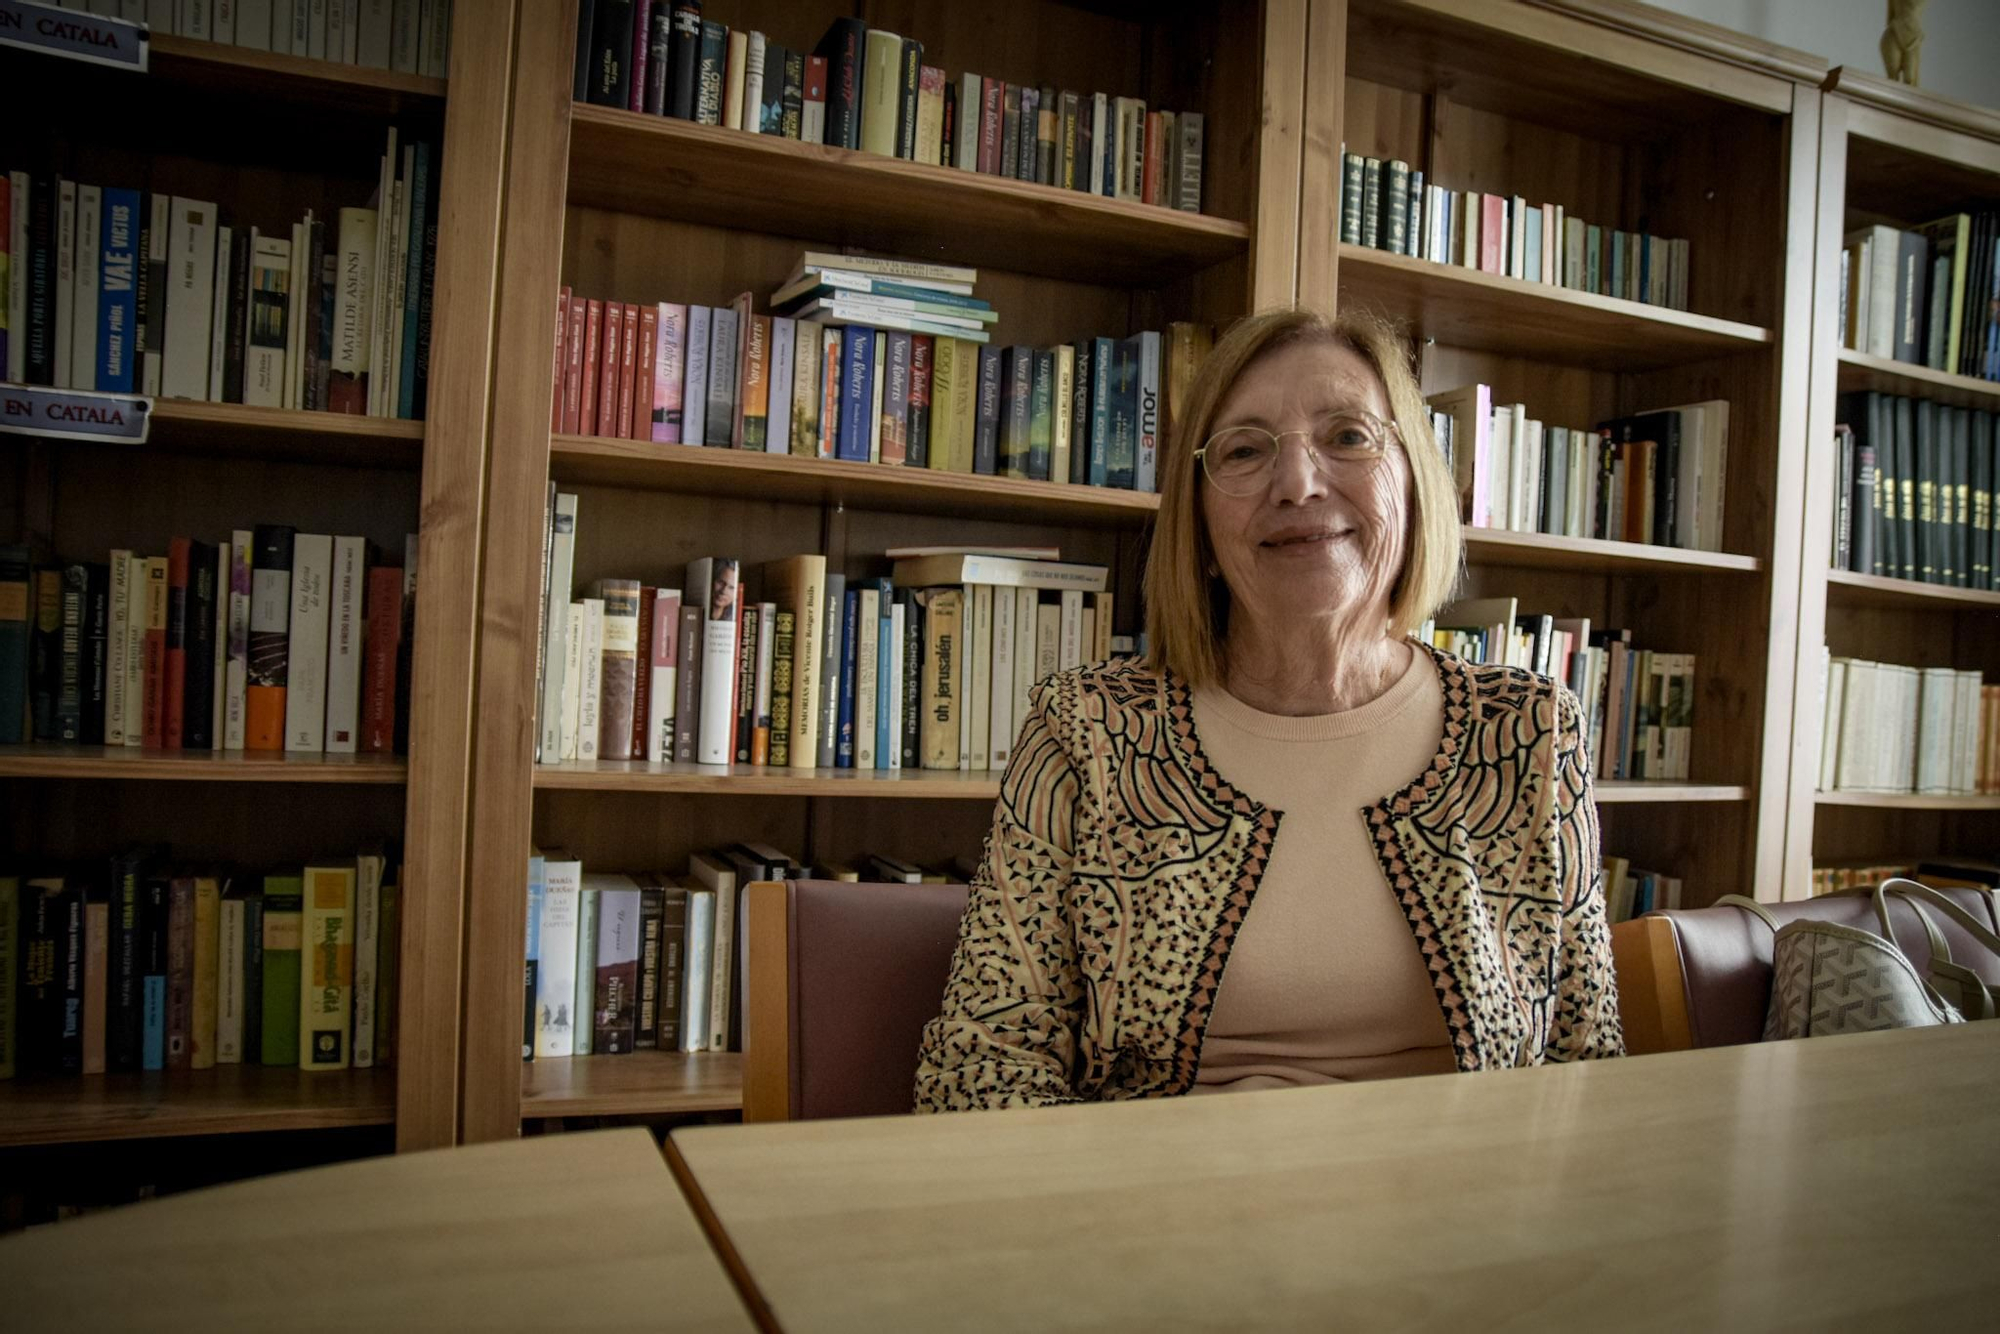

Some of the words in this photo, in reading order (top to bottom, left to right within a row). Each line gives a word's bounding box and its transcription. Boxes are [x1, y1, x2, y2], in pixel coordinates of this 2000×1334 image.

[710, 72, 721, 111] DIABLO
[1065, 159, 1074, 189] OMBRE
[111, 205, 130, 248] VICTUS
[139, 229, 149, 272] CAPITANA
[103, 251, 133, 291] VAE
[344, 251, 360, 298] ASENSI
[138, 274, 147, 301] VELLA
[108, 304, 124, 331] PIÑOL
[342, 300, 357, 361] MATILDE
[666, 314, 678, 336] Nora
[716, 320, 726, 352] LAURA
[749, 321, 764, 360] Roberts
[853, 335, 867, 359] Nora
[893, 338, 906, 362] Nora
[108, 335, 122, 376] SÁNCHEZ
[663, 340, 678, 378] Roberts
[914, 344, 926, 368] Nora
[985, 355, 997, 379] Nora
[1017, 355, 1029, 379] Nora
[1078, 354, 1089, 383] NORA
[713, 356, 724, 399] KINSALE
[747, 362, 762, 387] Nora
[851, 361, 865, 399] Roberts
[891, 364, 904, 402] Roberts
[912, 370, 926, 407] Roberts
[1038, 358, 1048, 393] Roberts
[5, 399, 32, 416] EN
[984, 381, 997, 416] Roberts
[1016, 381, 1028, 417] Roberts
[1036, 396, 1047, 417] Nora
[1141, 387, 1156, 449] amor
[116, 555, 126, 587] MADRE
[299, 566, 310, 593] Iglesia
[115, 592, 125, 604] TU
[311, 597, 320, 607] de
[343, 575, 351, 603] TOSCANA
[114, 608, 125, 621] YO,
[299, 595, 309, 613] Una
[342, 614, 350, 622] EN
[343, 604, 350, 612] LA
[340, 624, 350, 644] VIÑEDO
[911, 625, 917, 637] LA
[341, 646, 349, 654] UN
[803, 640, 812, 671] Vicente
[376, 652, 386, 688] DUEÑAS
[803, 674, 811, 685] de
[934, 634, 952, 699] jerusalén
[112, 674, 122, 721] CHRISTIANE
[375, 692, 383, 720] MARÍA
[800, 686, 810, 735] MEMORIAS
[645, 919, 657, 938] ALMA
